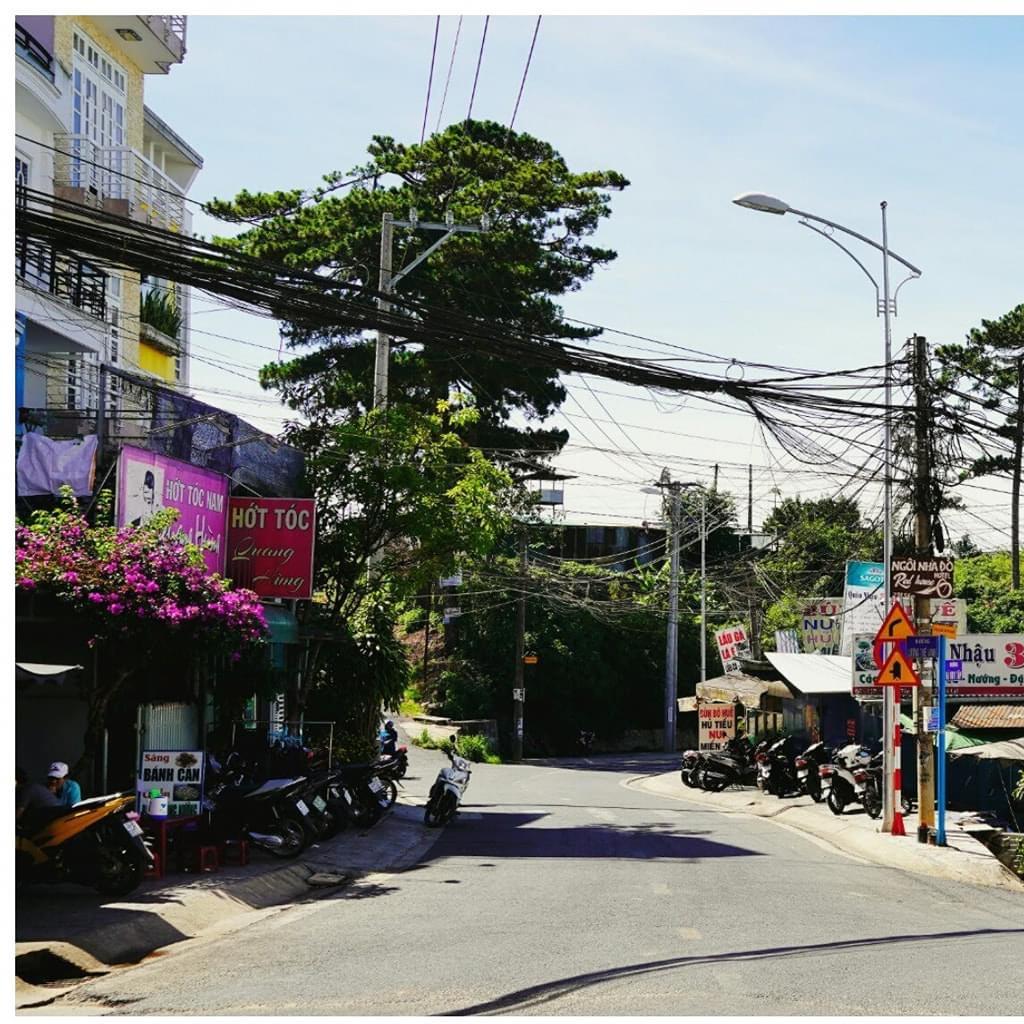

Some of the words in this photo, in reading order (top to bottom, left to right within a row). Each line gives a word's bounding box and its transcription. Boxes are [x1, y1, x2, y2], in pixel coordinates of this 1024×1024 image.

[165, 479, 186, 502] HỚT
[187, 482, 205, 507] TÓC
[206, 491, 224, 512] NAM
[231, 502, 269, 530] HỚT
[274, 503, 310, 531] TÓC
[231, 536, 296, 565] Quang
[891, 558, 917, 572] NGÔI
[893, 572, 915, 589] Red
[949, 642, 995, 668] Nhậu
[967, 673, 1001, 687] Nướng
[143, 753, 170, 765] Sáng
[143, 764, 174, 782] BÁNH
